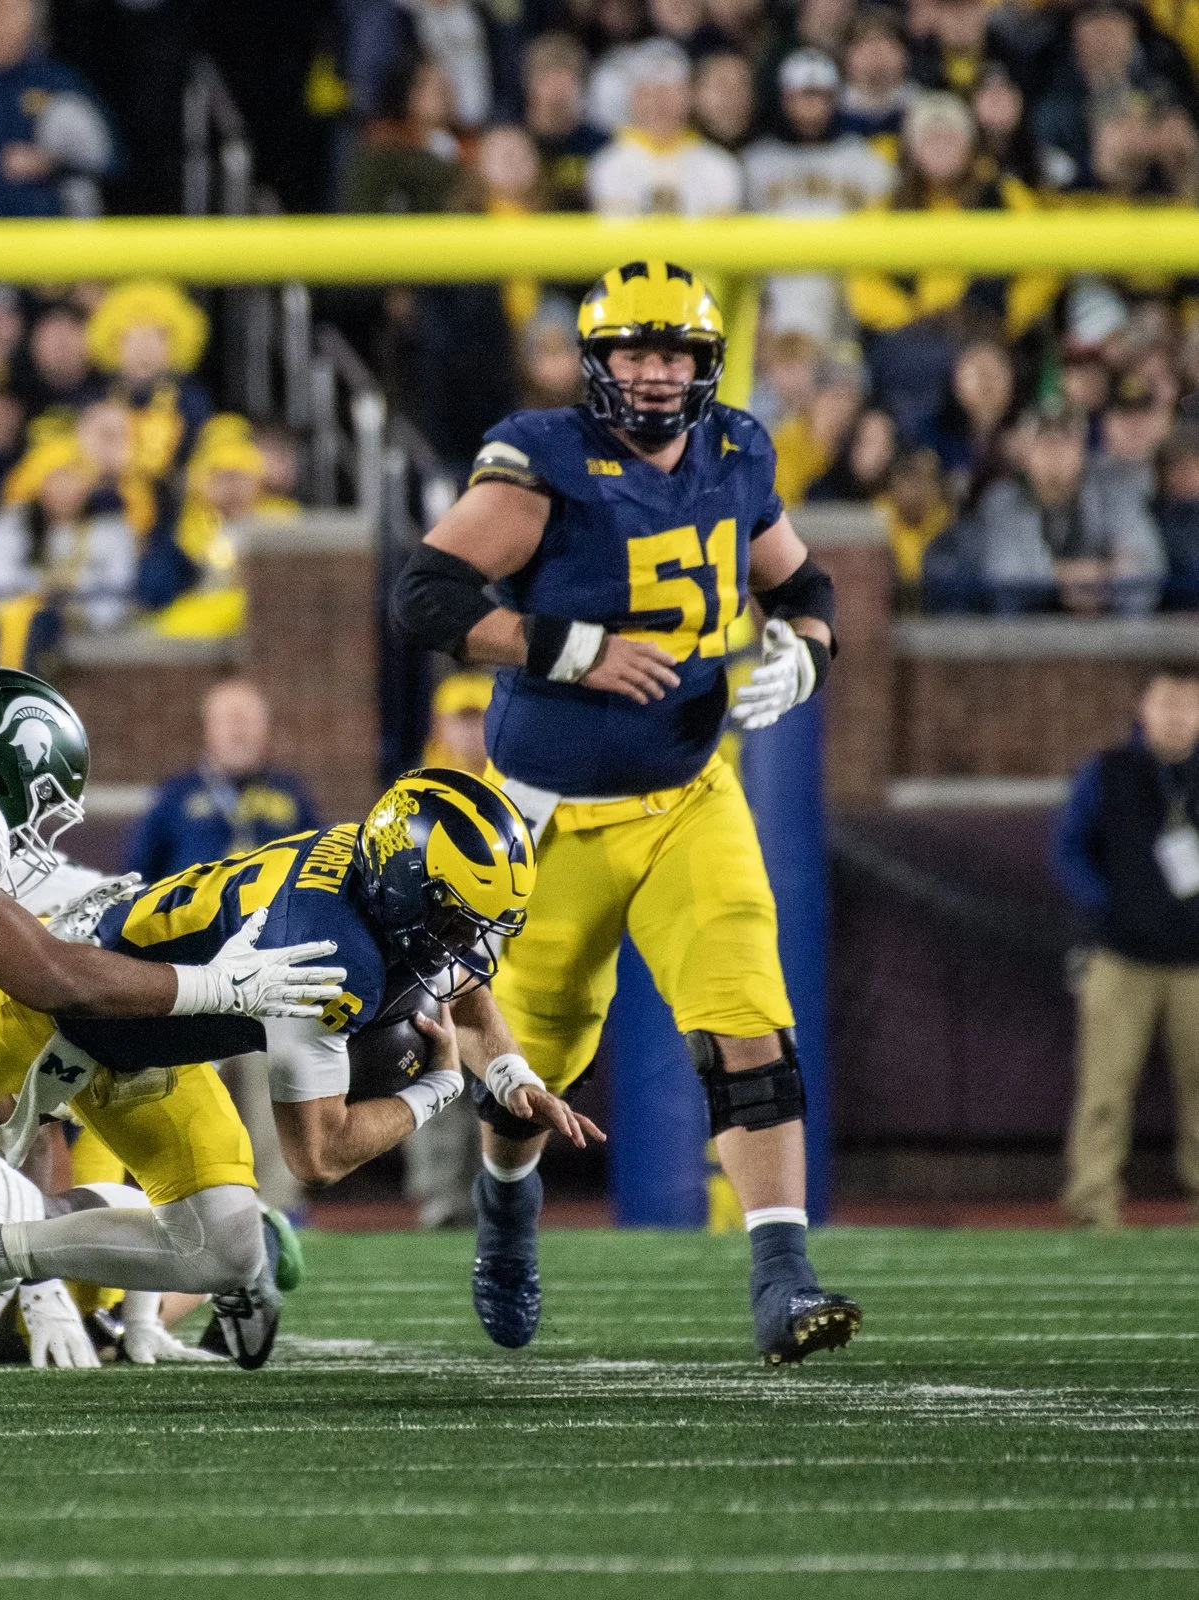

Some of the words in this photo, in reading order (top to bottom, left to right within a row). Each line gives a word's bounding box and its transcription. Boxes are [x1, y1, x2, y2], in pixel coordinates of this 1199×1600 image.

[615, 518, 738, 662] 51
[299, 988, 363, 1034] 6
[39, 1052, 87, 1085] M
